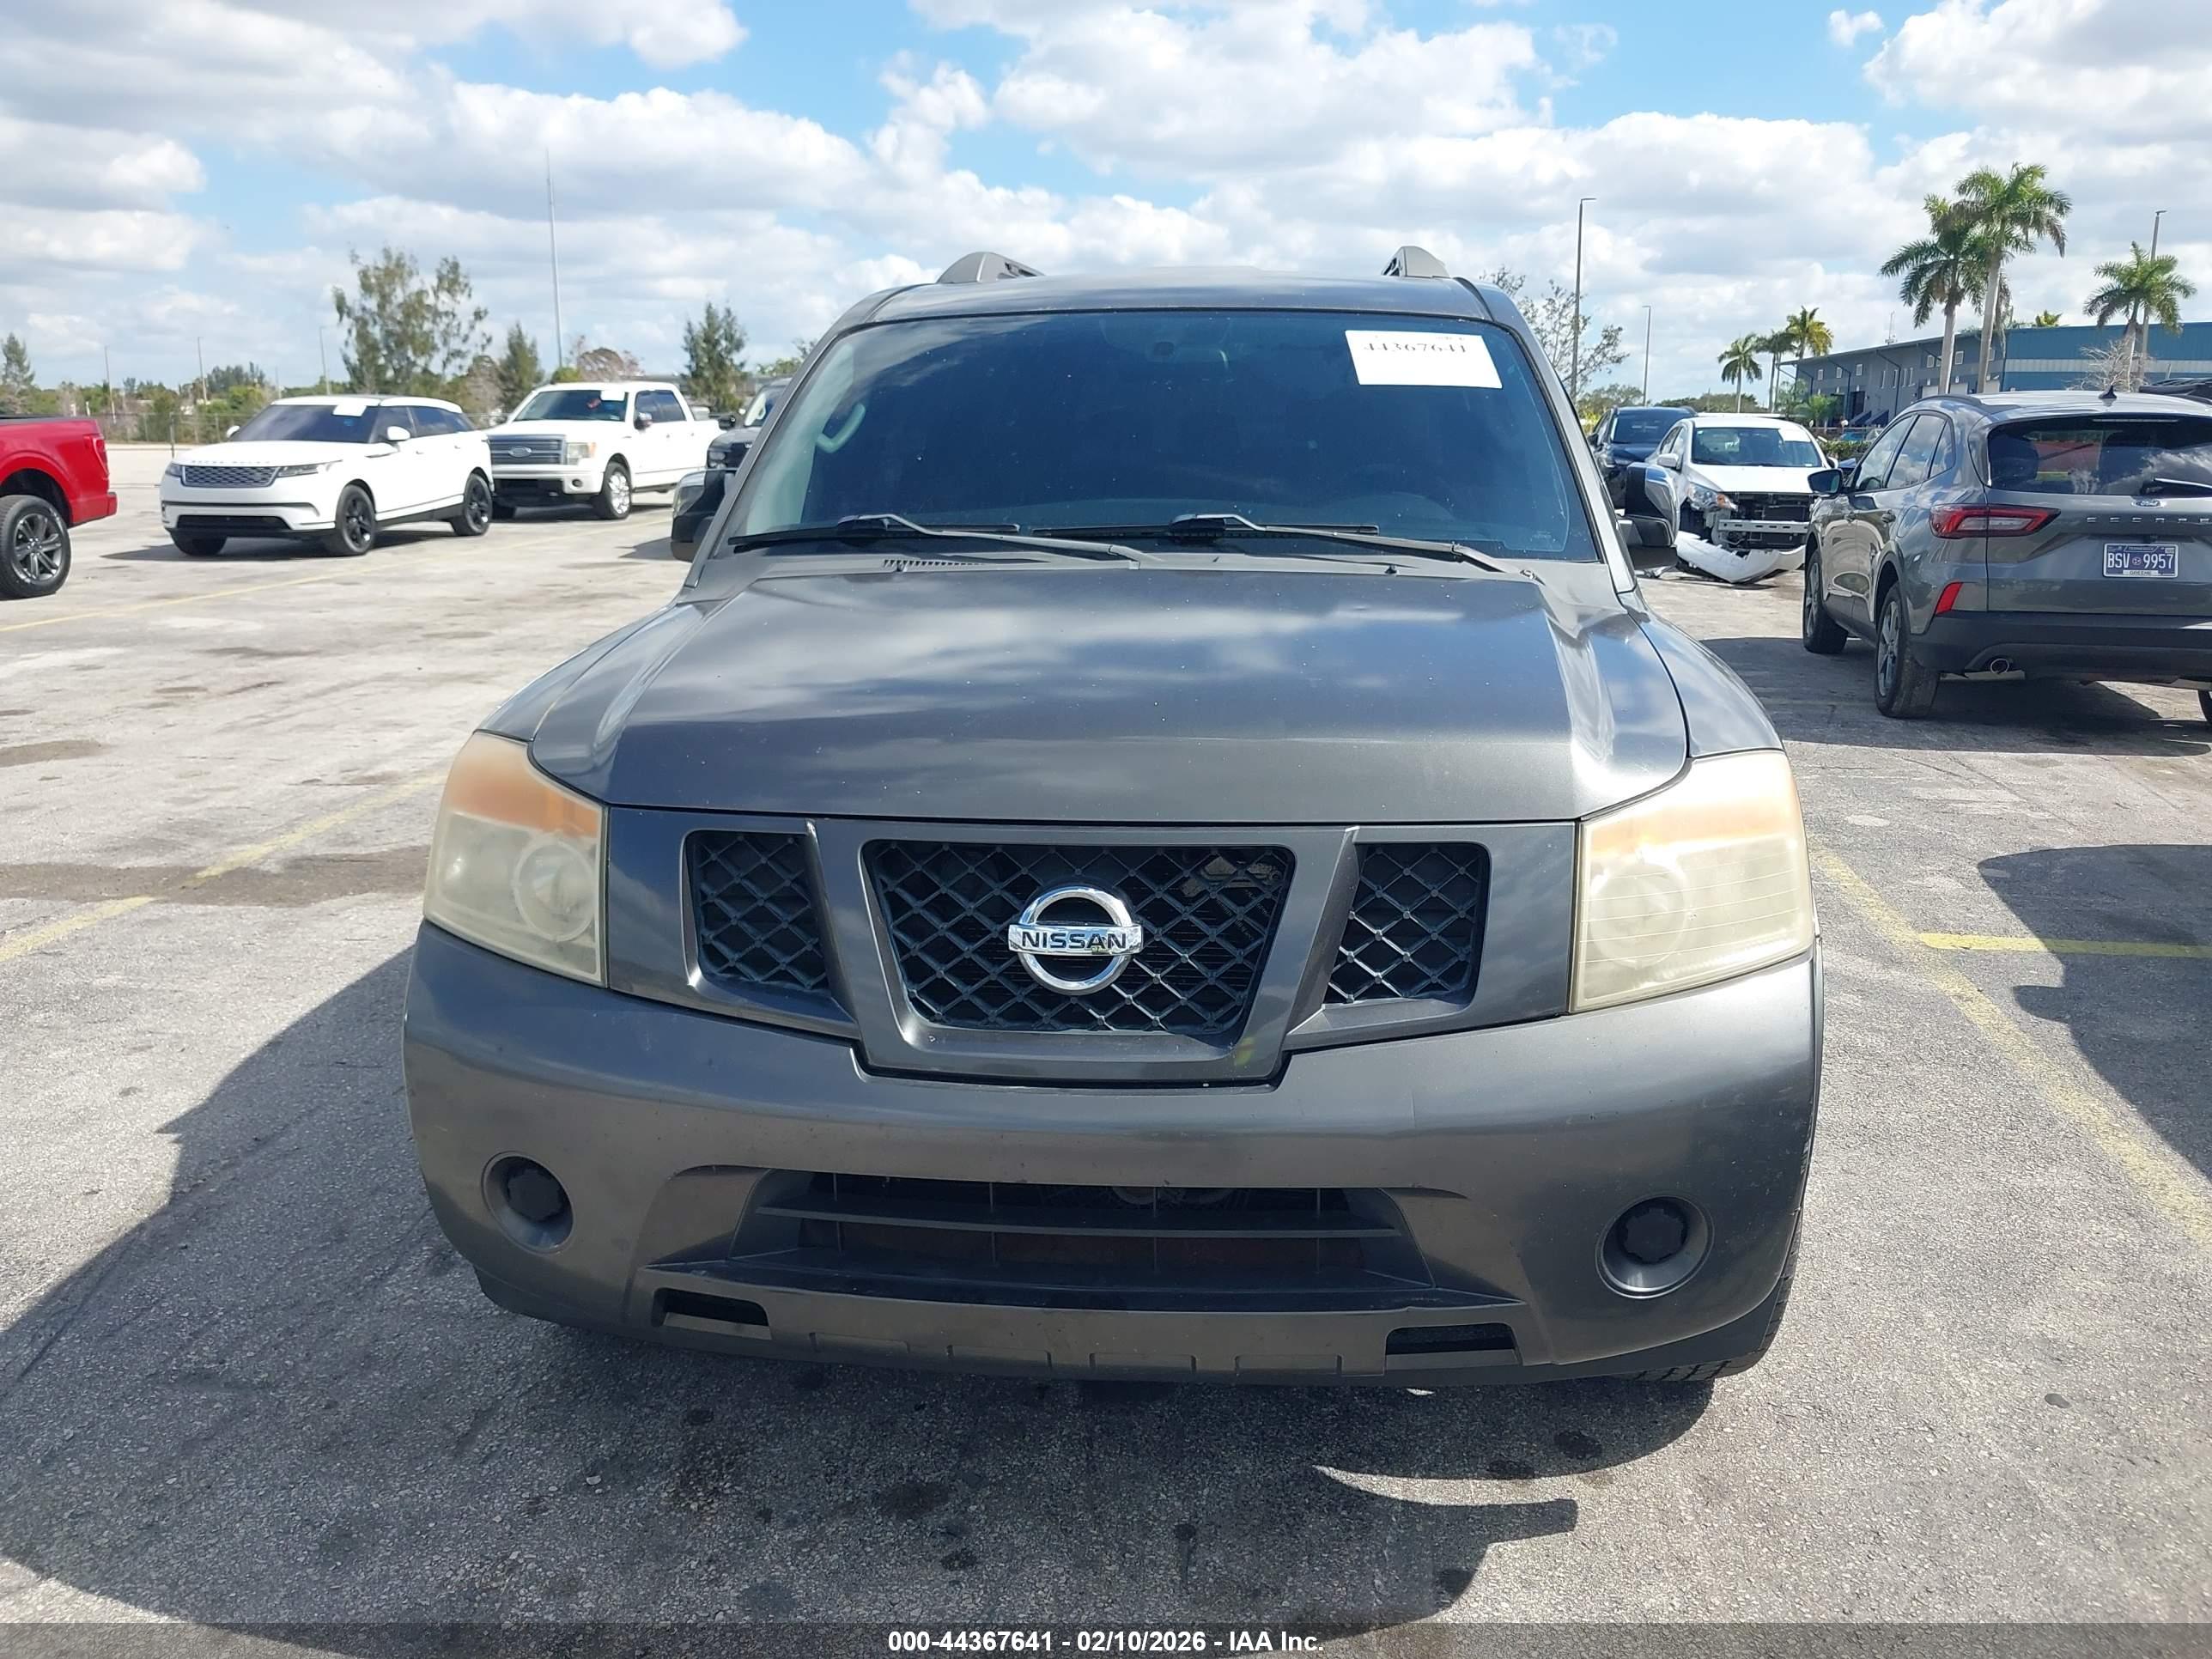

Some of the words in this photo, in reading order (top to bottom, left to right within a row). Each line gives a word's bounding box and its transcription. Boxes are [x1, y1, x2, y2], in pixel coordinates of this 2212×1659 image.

[2107, 552, 2130, 568] BSV
[2143, 554, 2173, 568] 9957
[1021, 931, 1127, 949] NISSAN
